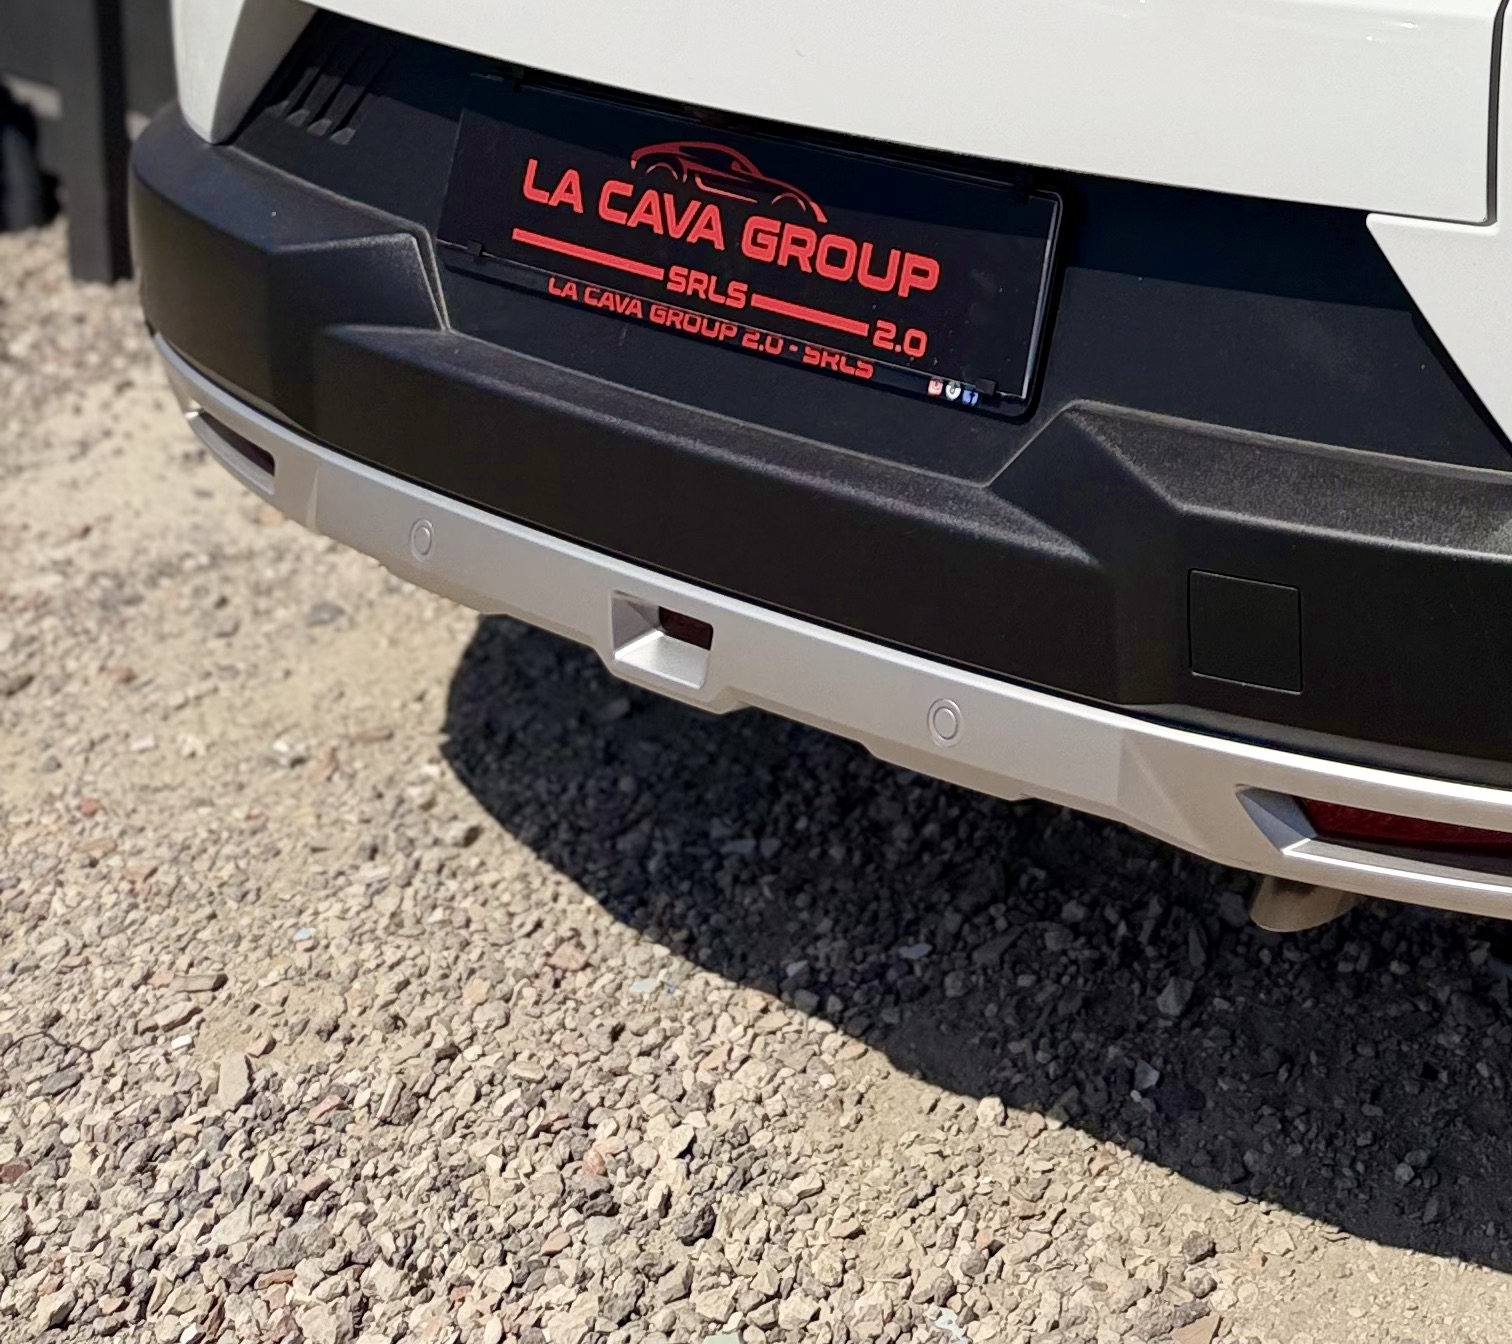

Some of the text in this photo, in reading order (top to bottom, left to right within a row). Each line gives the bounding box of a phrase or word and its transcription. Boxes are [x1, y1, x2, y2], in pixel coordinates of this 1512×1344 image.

[521, 157, 941, 299] LA CAVA GROUP
[547, 277, 579, 301] LA
[582, 285, 643, 318] CAVA
[648, 303, 739, 341] GROUP
[741, 328, 784, 356] 2.0
[802, 344, 875, 380] SRLS
[665, 264, 929, 359] SRLS 2.0
